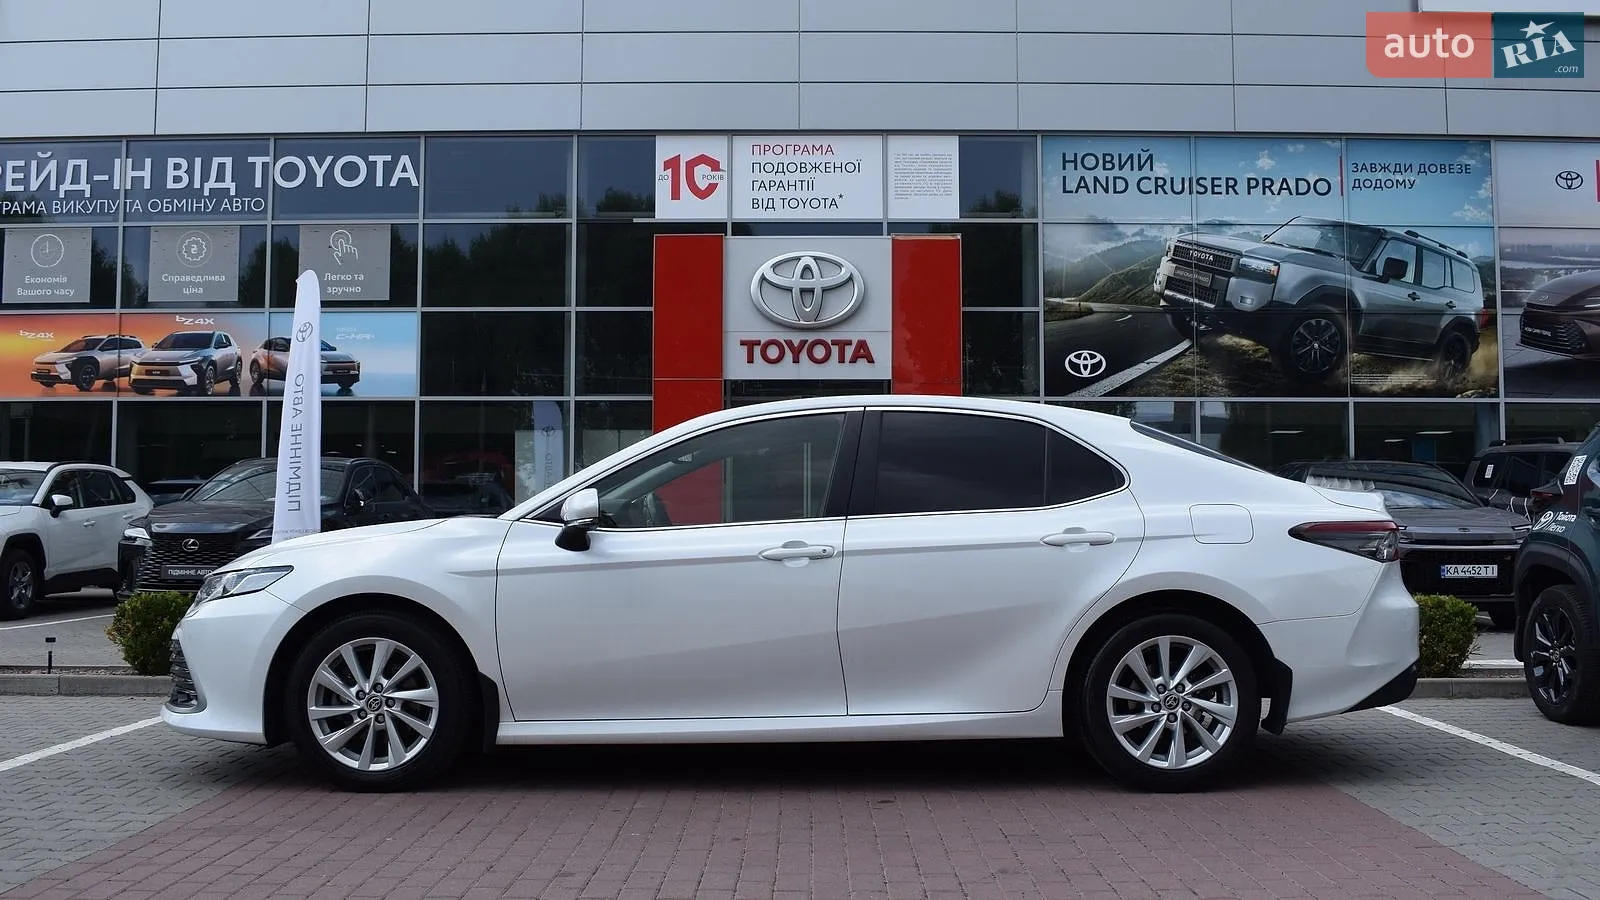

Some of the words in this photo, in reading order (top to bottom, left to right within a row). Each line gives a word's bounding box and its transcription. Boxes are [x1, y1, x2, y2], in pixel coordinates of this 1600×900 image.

[751, 144, 835, 156] ПРОГРАМА
[1061, 147, 1155, 173] НОВИЙ
[751, 160, 862, 176] ПОДОВЖЕНОЇ
[1350, 160, 1413, 177] ЗАВЖДИ
[1416, 160, 1472, 178] ДОВЕЗЕ
[0, 151, 152, 199] ЕЙД-ІН
[166, 156, 237, 196] ВІД
[248, 154, 420, 188] TOYOTA
[658, 174, 670, 182] ДО
[751, 177, 815, 192] ГАРАНТІЇ
[1061, 175, 1129, 196] LAND
[1133, 175, 1240, 197] CRUISER
[1246, 176, 1333, 198] PRADO
[1350, 177, 1417, 193] ДОДОМУ
[0, 200, 47, 215] РАМА
[52, 199, 120, 215] ВИКУПУ
[125, 199, 143, 213] ТА
[147, 198, 215, 213] ОБМІНУ
[220, 198, 265, 213] АВТО
[751, 197, 776, 212] ВІД
[1189, 250, 1214, 262] TOYOTA
[25, 275, 68, 284] Економія
[161, 273, 226, 284] Справедлива
[324, 272, 352, 281] Легко
[17, 287, 52, 296] Вашого
[54, 289, 75, 297] часу
[183, 285, 204, 295] ціна
[326, 286, 362, 295] зручно
[739, 338, 876, 365] TOYOTA
[1446, 566, 1459, 575] KA
[1461, 566, 1482, 576] 4452
